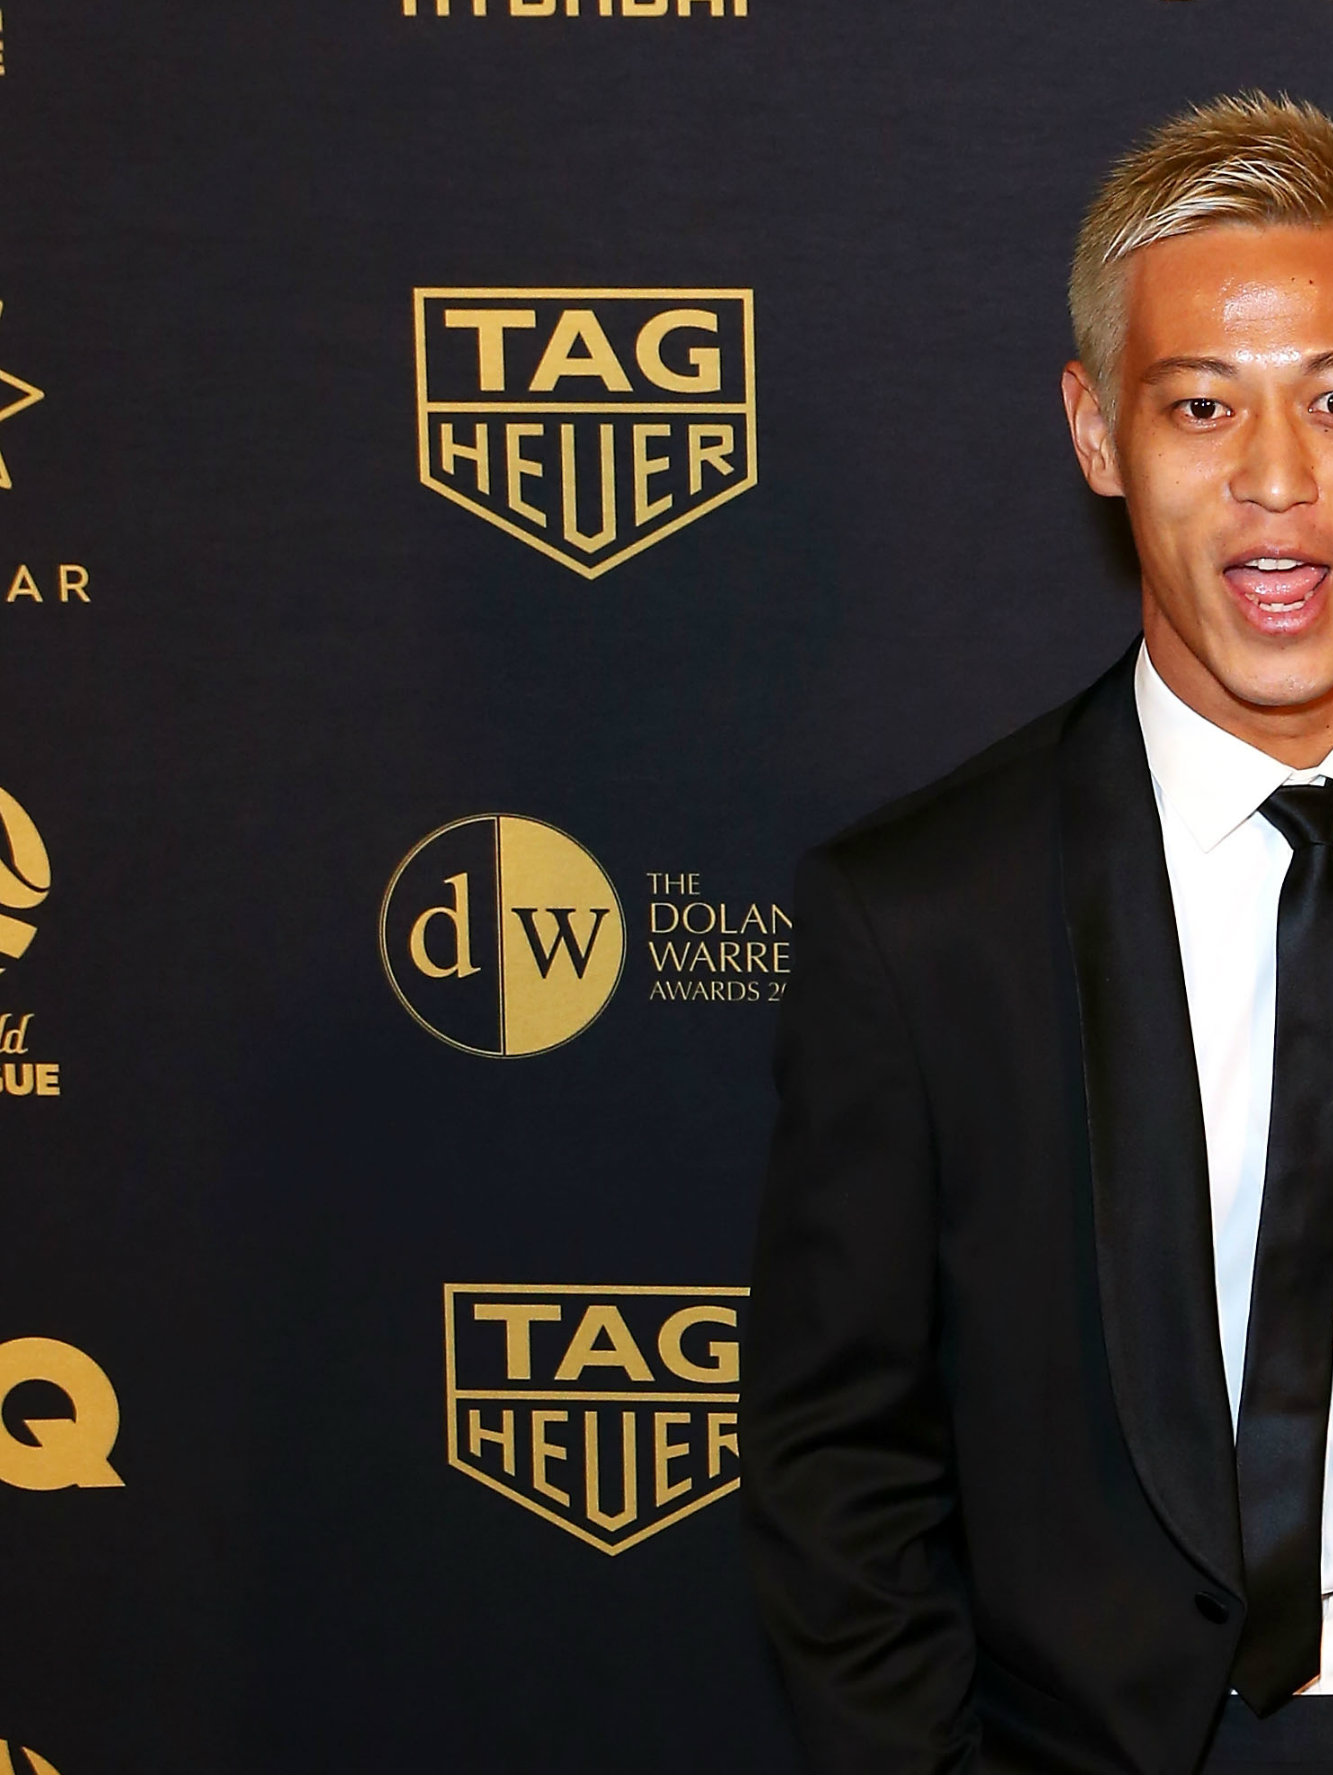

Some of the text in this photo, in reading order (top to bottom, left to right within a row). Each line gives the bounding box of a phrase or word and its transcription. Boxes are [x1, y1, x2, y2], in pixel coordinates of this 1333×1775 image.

[444, 308, 721, 394] TAG
[440, 422, 734, 554] HEUER
[646, 873, 700, 895] THE
[650, 902, 793, 934] DOLAN
[649, 979, 761, 1002] AWARDS
[0, 1063, 60, 1096] UE
[473, 1303, 741, 1384] TAG
